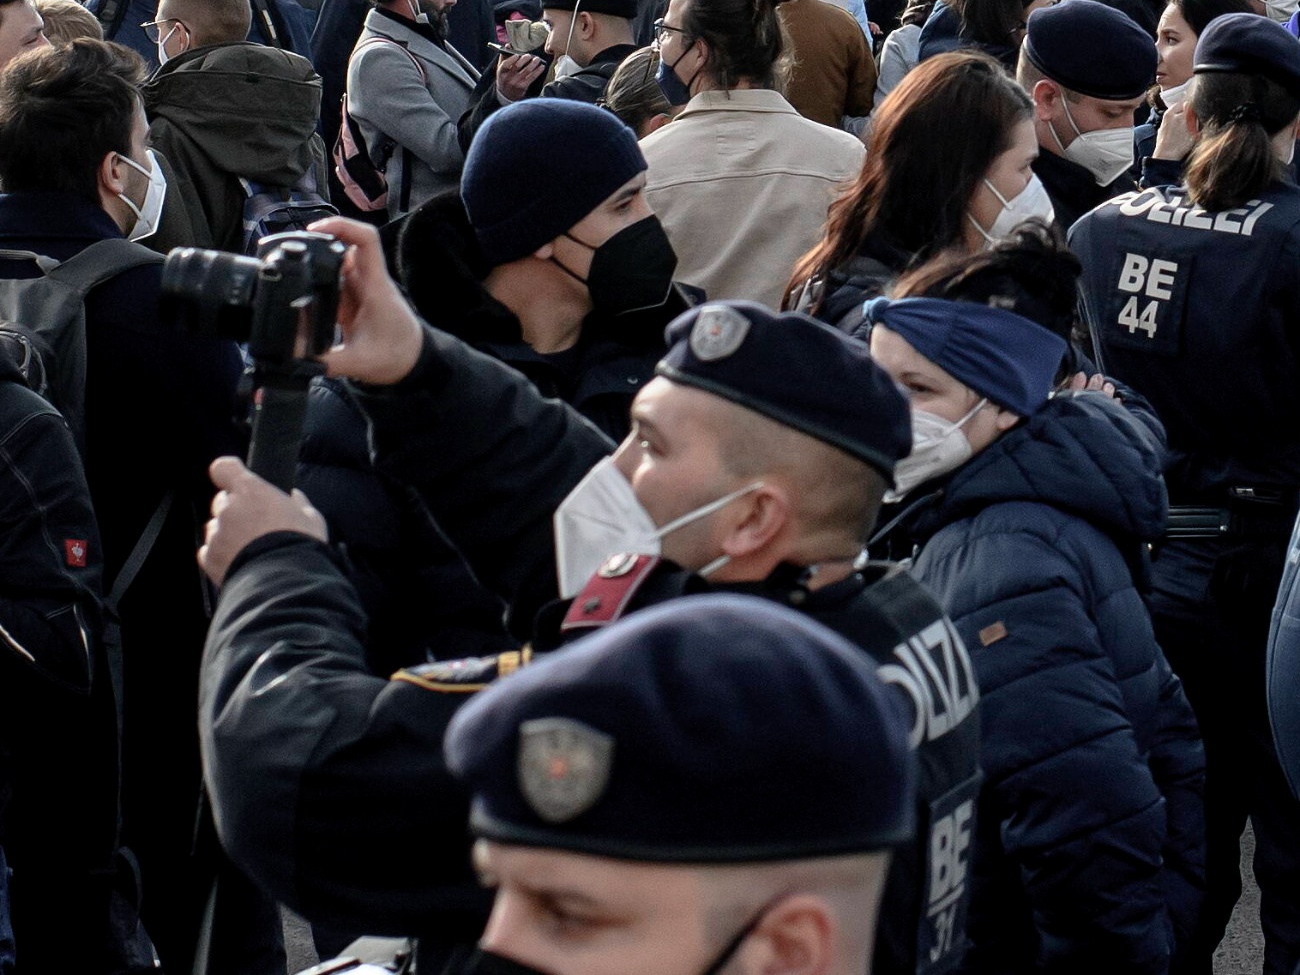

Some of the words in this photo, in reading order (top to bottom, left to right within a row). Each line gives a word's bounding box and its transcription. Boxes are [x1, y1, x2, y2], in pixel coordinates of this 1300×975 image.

[1117, 252, 1178, 301] BE
[1117, 295, 1160, 339] 44
[876, 615, 980, 752] OLIZ
[928, 799, 974, 905] BE
